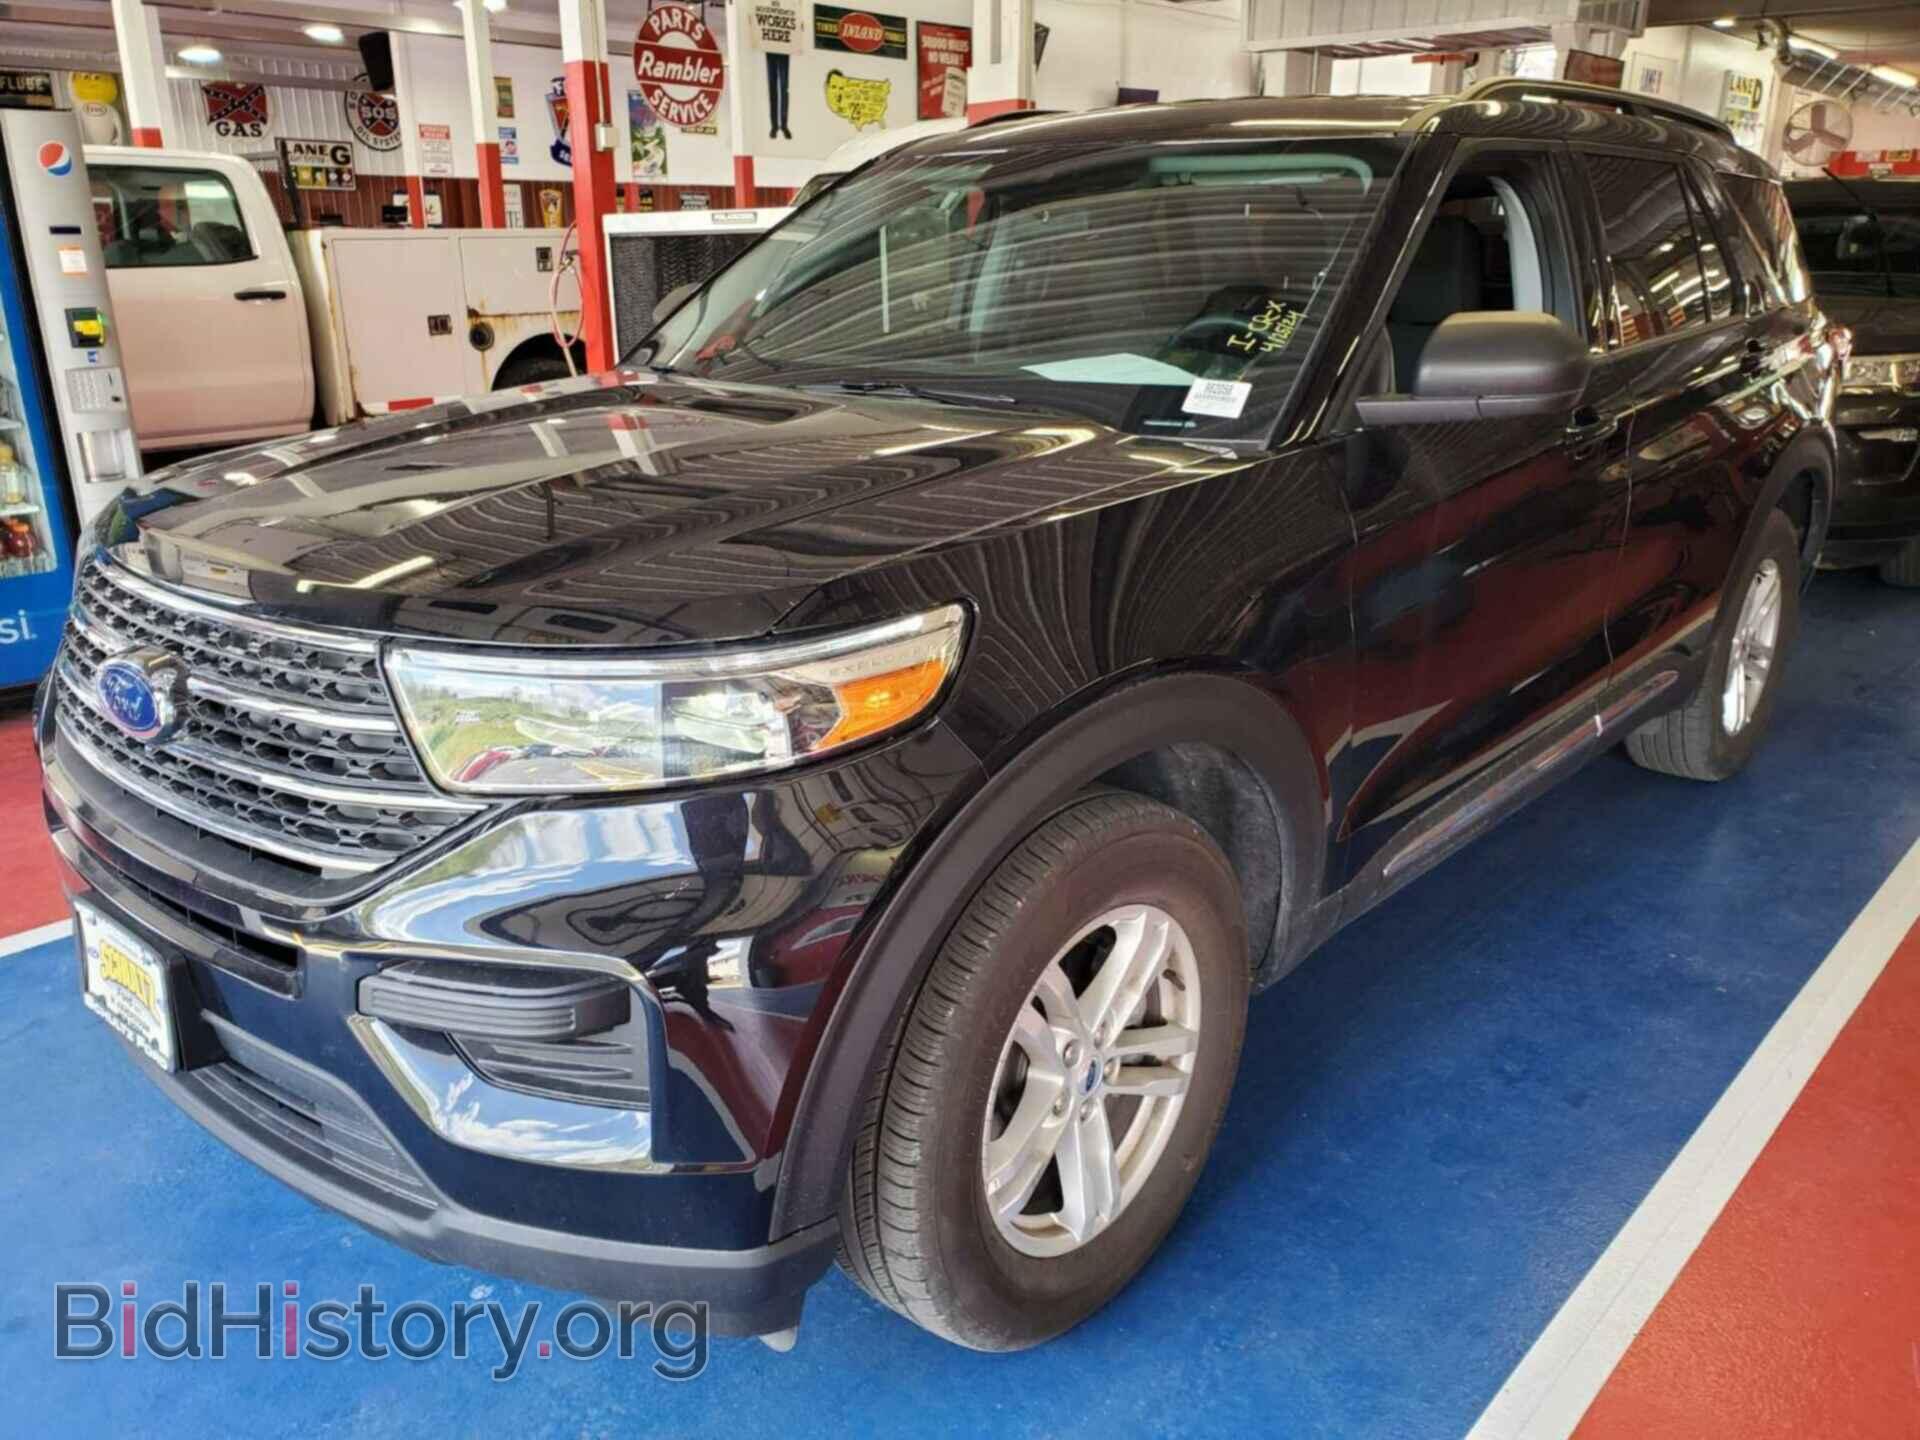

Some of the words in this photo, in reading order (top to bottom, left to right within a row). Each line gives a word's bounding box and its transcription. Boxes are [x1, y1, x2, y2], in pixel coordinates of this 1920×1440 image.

[649, 7, 705, 41] PARTS
[755, 14, 796, 30] WORKS
[762, 28, 792, 43] HERE
[638, 50, 721, 84] Rambler
[649, 88, 713, 124] SERVICE
[215, 121, 262, 138] GAS
[330, 144, 351, 166] G
